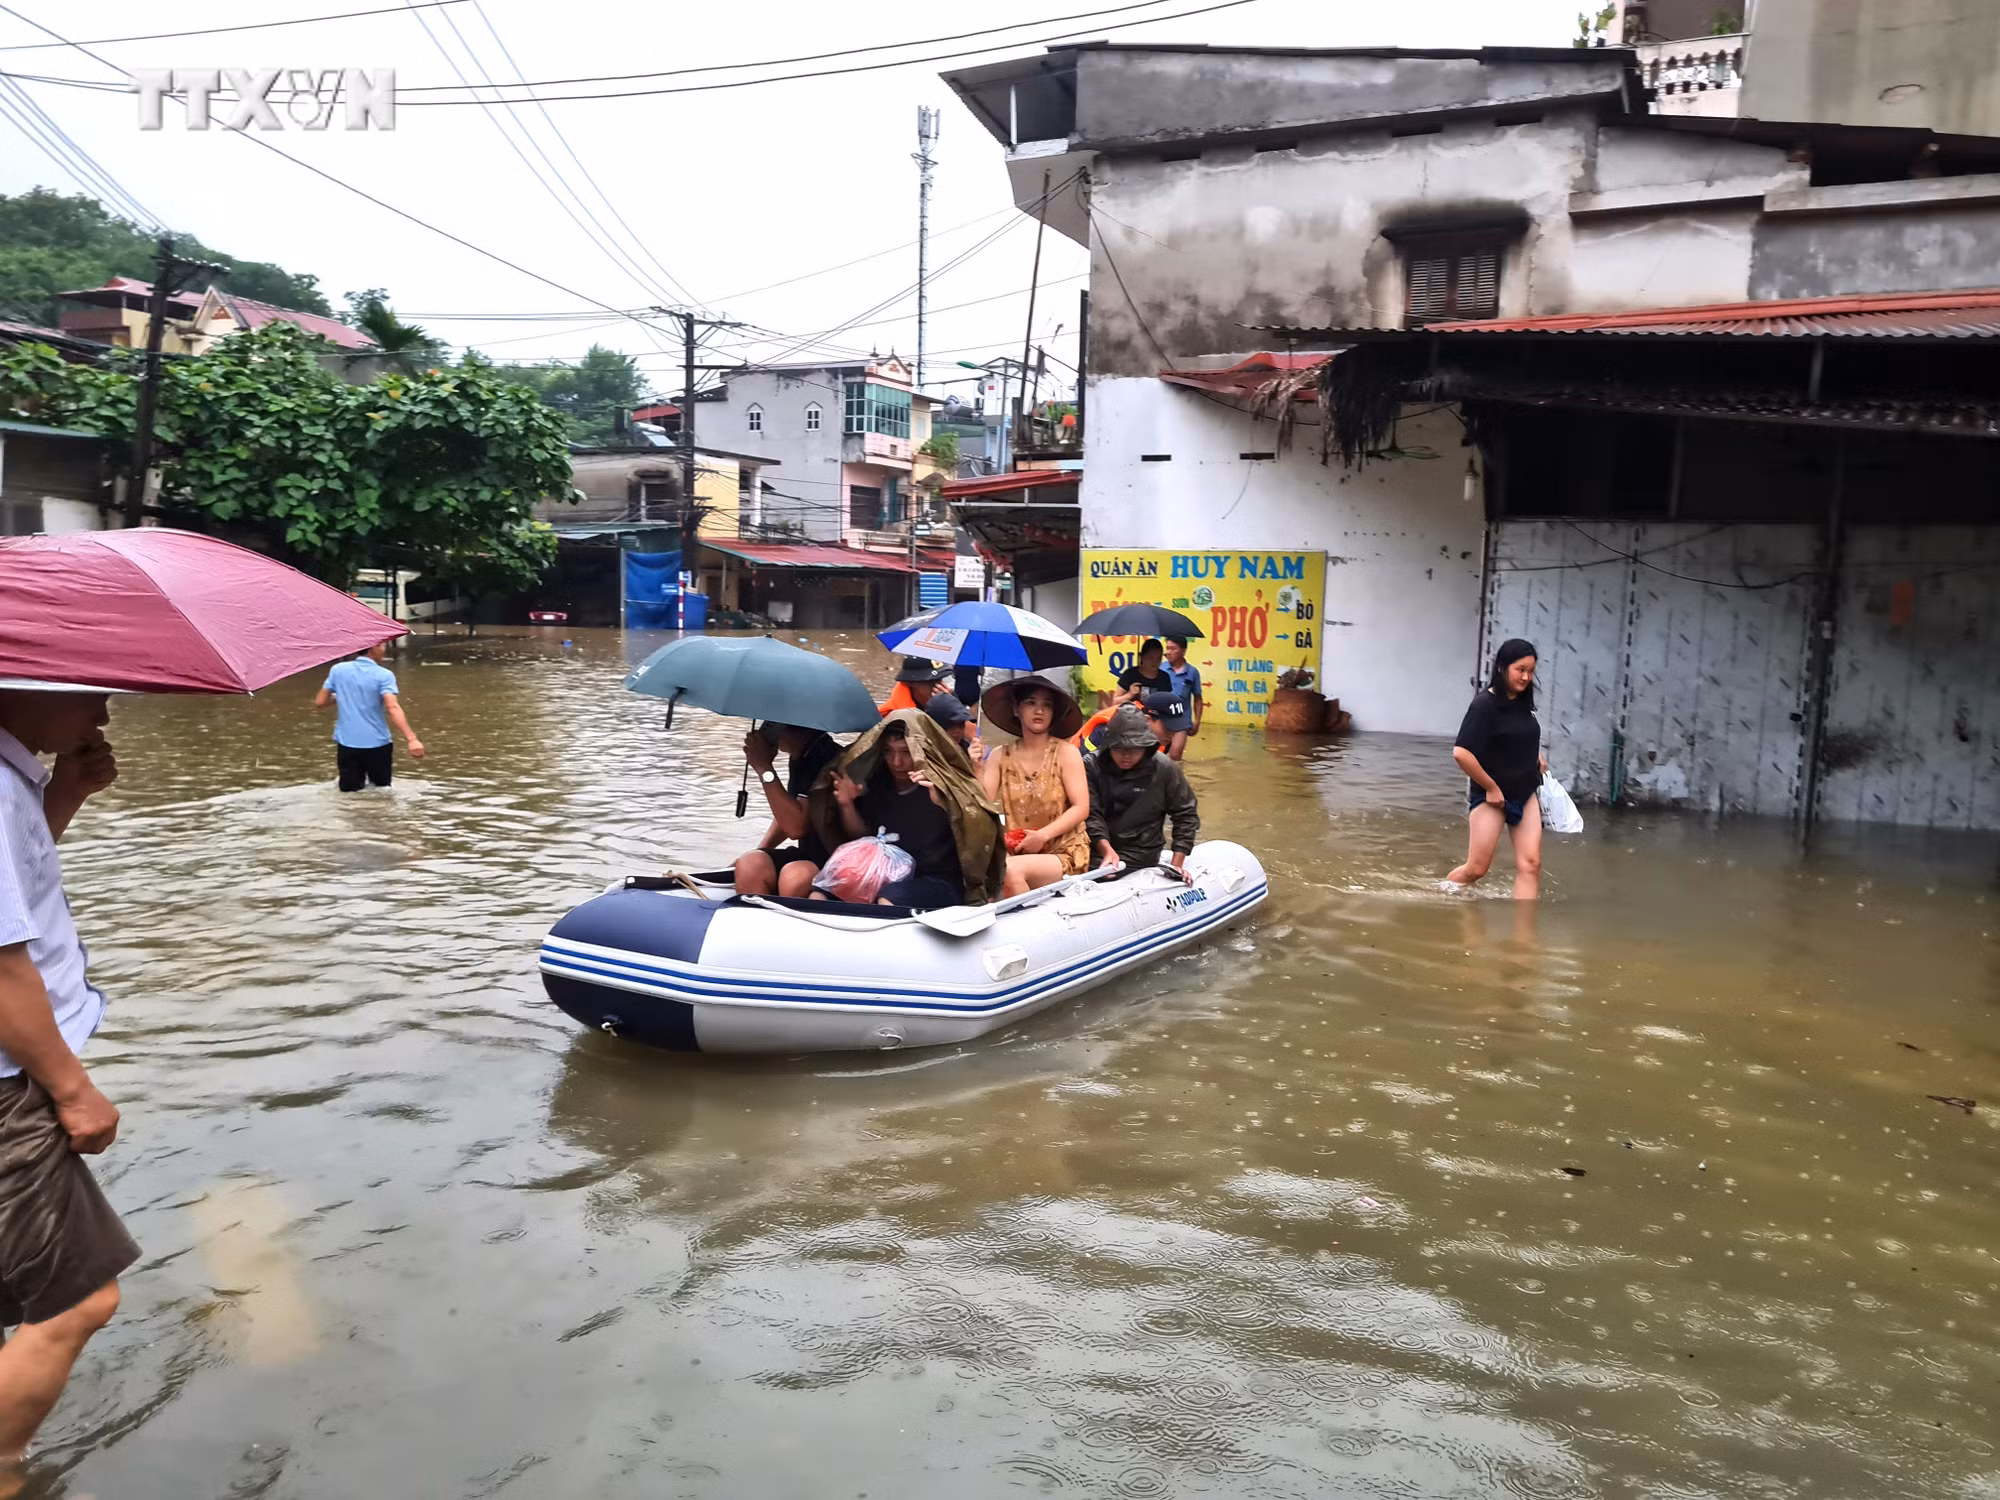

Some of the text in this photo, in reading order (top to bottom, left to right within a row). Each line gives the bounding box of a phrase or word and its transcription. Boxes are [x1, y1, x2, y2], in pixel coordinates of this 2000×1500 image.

[1090, 556, 1306, 580] QUÁN ĂN HUY NAM
[1210, 589, 1270, 648] PHỞ
[1296, 599, 1314, 620] BÒ
[1296, 628, 1313, 648] GÀ
